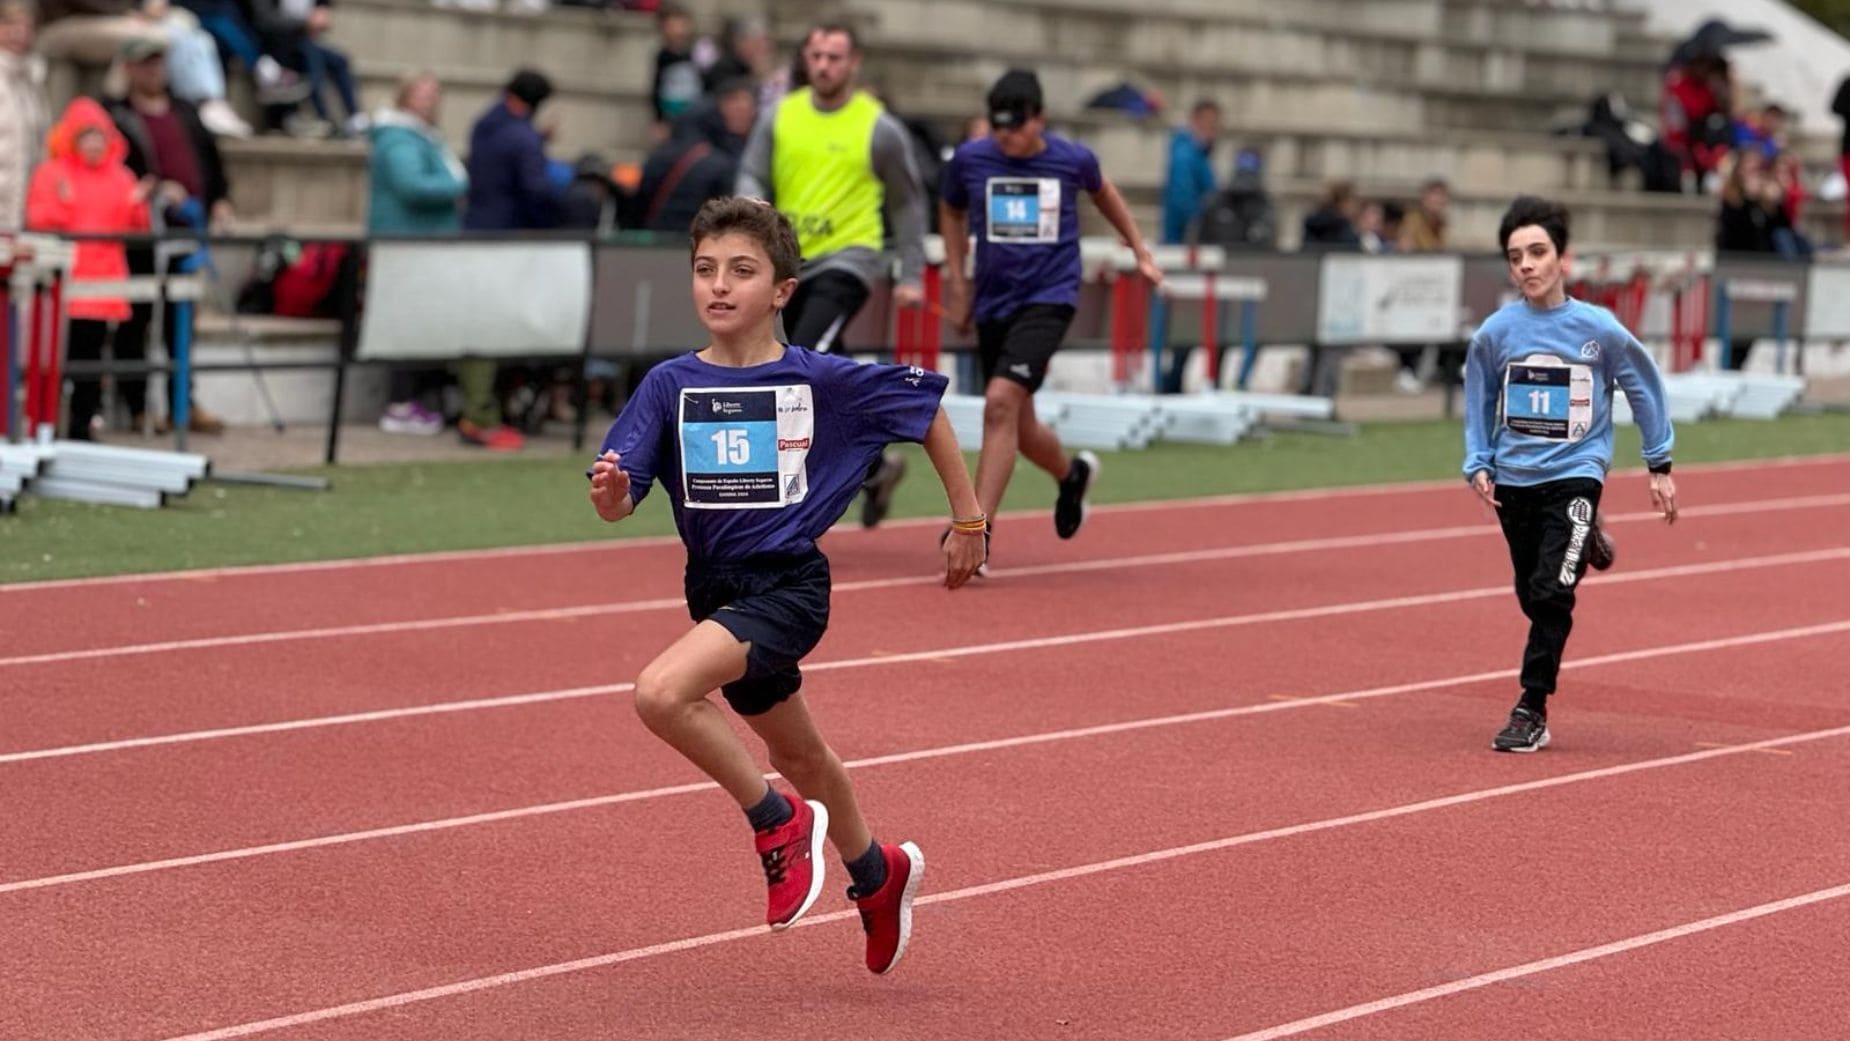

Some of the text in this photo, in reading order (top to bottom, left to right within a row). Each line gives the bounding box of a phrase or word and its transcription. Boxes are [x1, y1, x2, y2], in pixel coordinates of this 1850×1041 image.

[1528, 390, 1550, 414] 11
[711, 429, 750, 465] 15
[779, 439, 808, 449] Pascual
